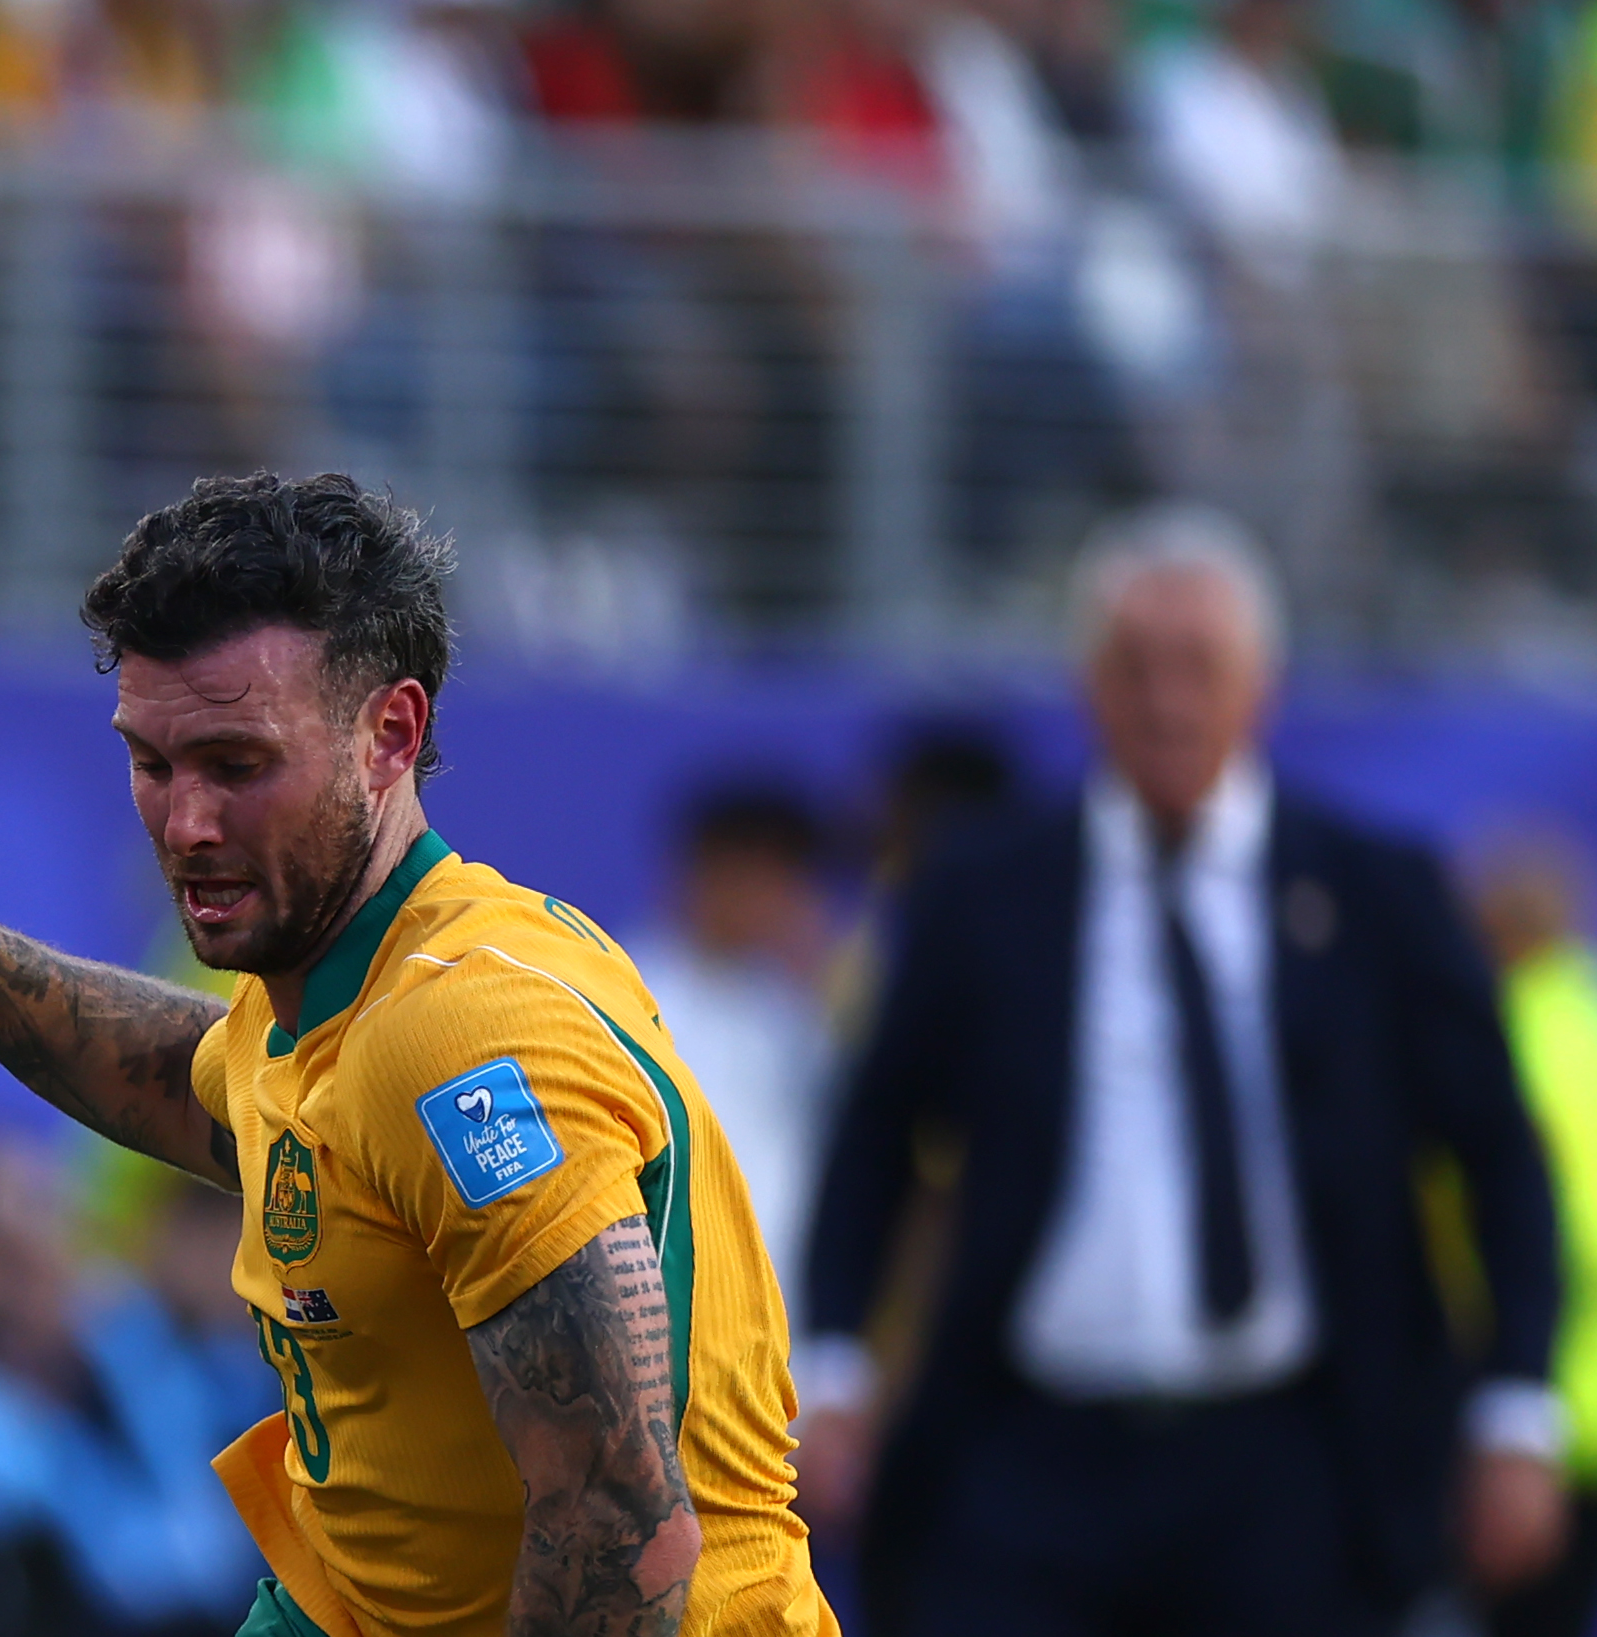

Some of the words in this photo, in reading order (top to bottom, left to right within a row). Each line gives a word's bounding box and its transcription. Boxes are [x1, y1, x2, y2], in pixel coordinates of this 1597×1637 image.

[462, 1125, 499, 1155] Unite
[495, 1113, 517, 1137] For
[475, 1132, 527, 1173] PEACE
[495, 1161, 525, 1181] FIFA
